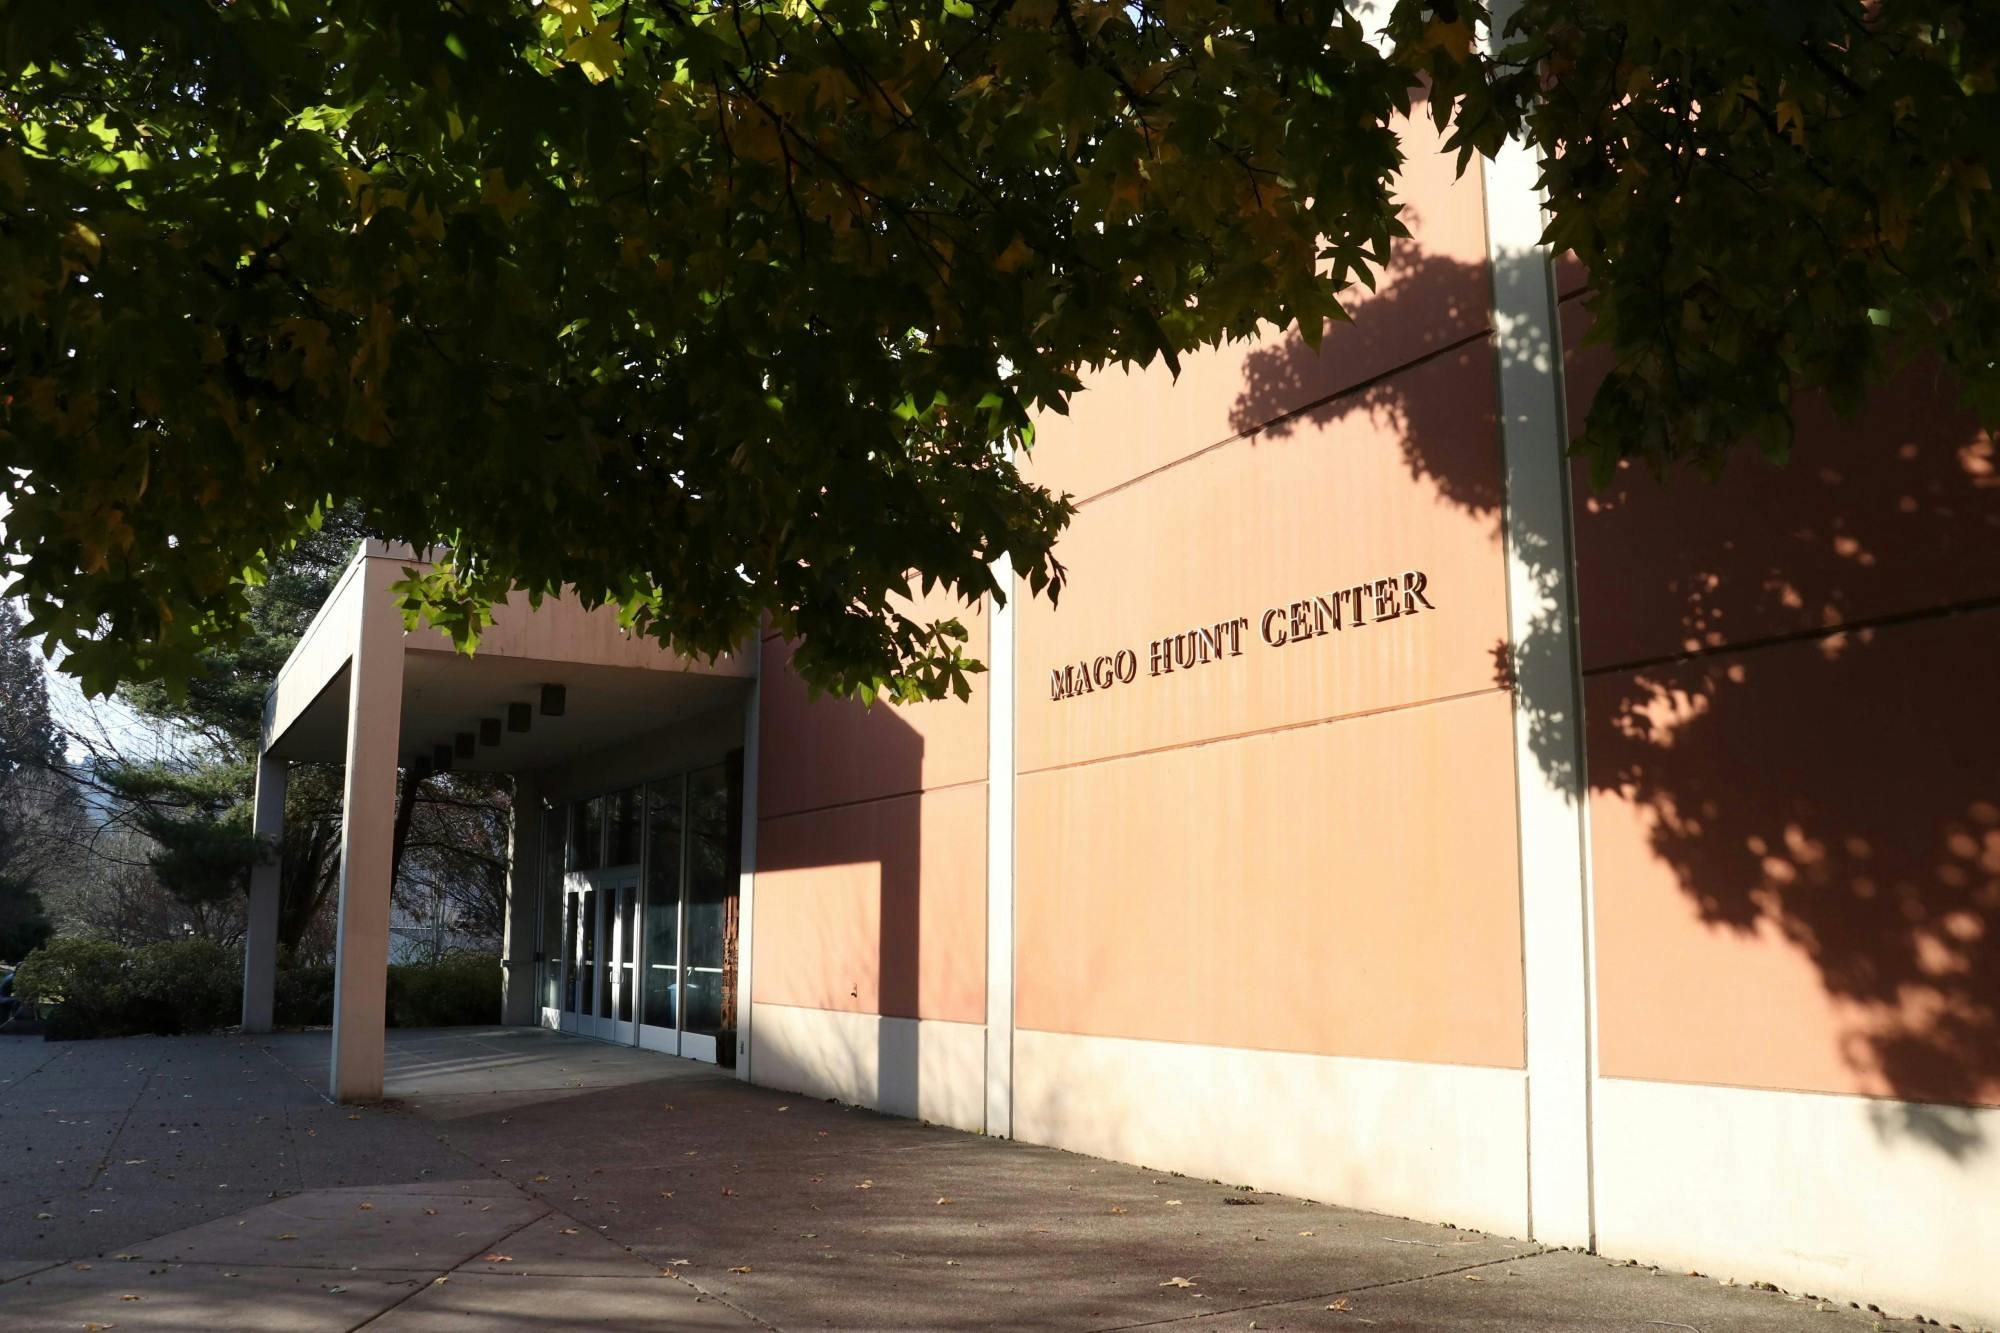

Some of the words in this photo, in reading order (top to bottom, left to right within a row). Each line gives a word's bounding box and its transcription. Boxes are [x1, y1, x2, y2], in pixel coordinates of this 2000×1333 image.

[1050, 648, 1138, 701] MAGO
[1147, 616, 1248, 676] HUNT
[1259, 570, 1436, 647] CENTER
